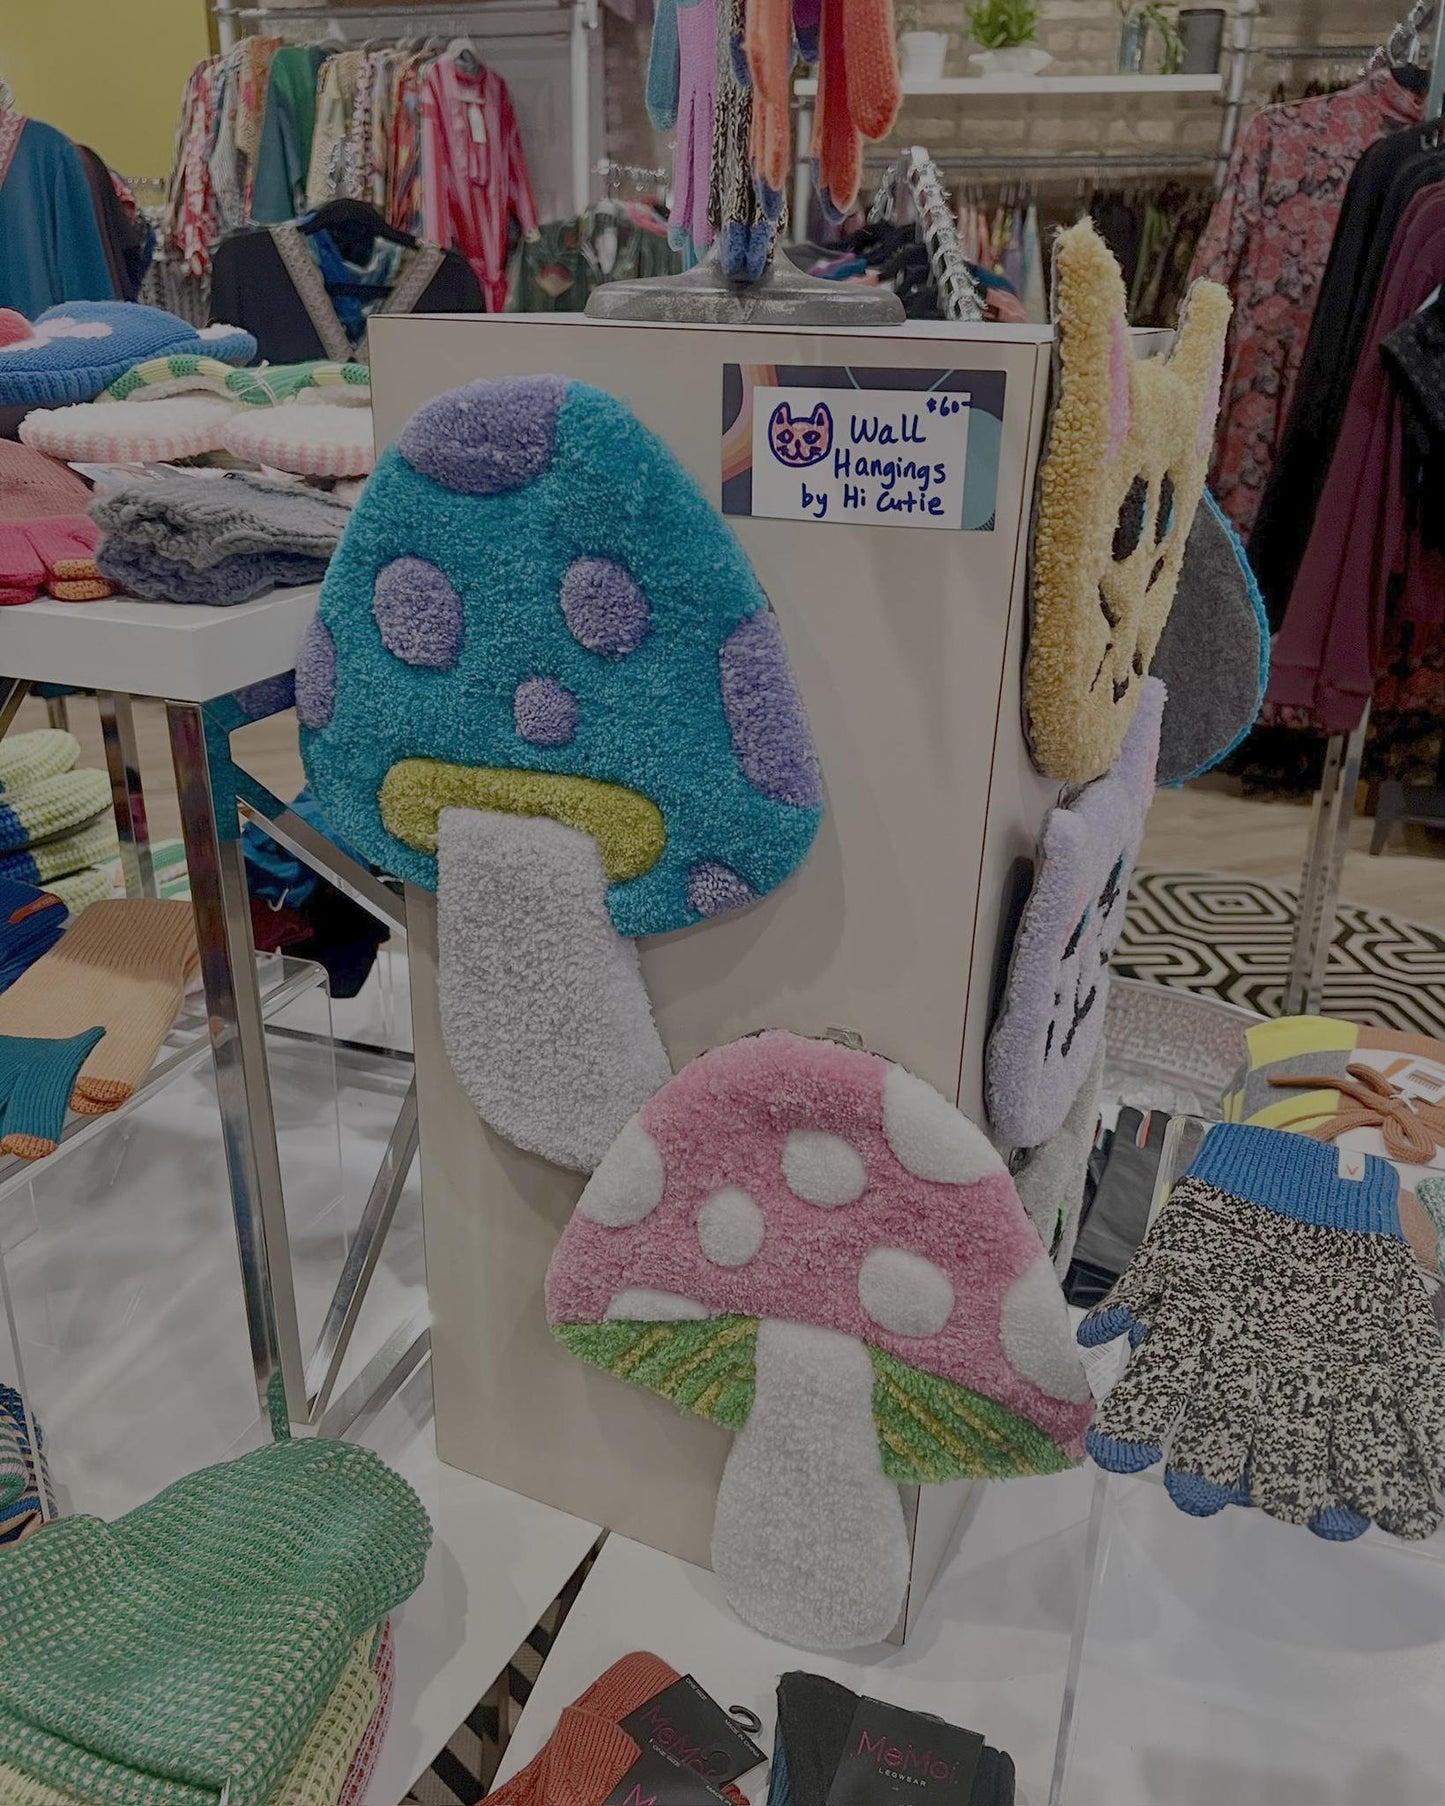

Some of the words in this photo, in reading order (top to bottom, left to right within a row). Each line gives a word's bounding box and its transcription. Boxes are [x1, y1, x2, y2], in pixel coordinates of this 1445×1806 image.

[850, 414, 926, 444] Wall
[834, 448, 946, 491] Hangings
[802, 483, 827, 518] by
[843, 484, 866, 509] Hi
[876, 491, 945, 516] Cutie
[878, 1766, 928, 1787] LEGWEAR
